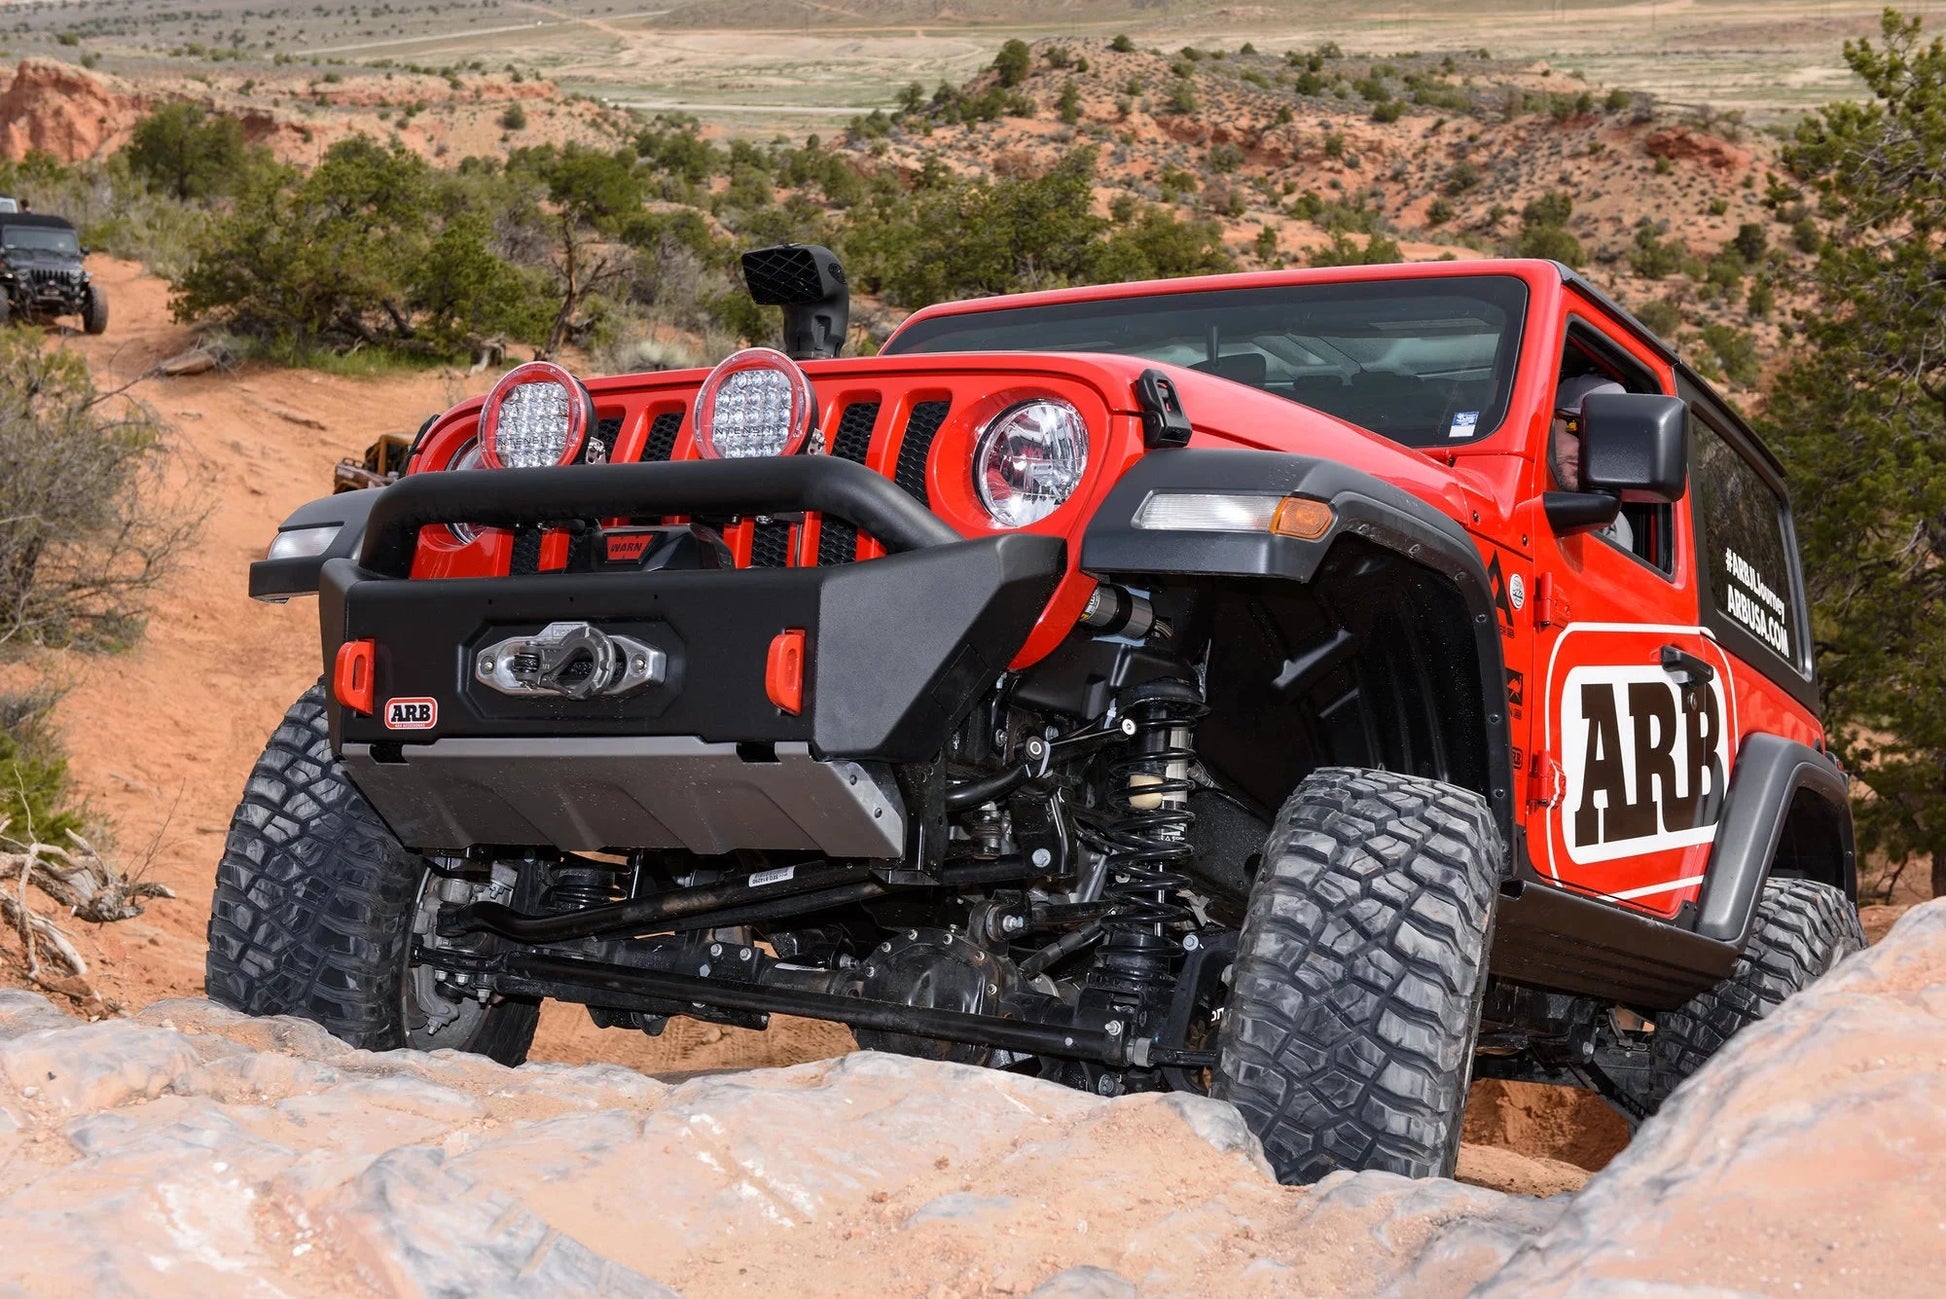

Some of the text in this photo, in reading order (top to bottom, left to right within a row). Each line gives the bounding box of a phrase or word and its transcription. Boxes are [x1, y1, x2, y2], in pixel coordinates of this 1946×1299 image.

[715, 424, 783, 436] NTENSITY
[610, 542, 643, 553] WARN
[1728, 584, 1790, 658] ARBUSA.COM
[391, 704, 431, 722] ARB
[1575, 682, 1726, 848] ARB
